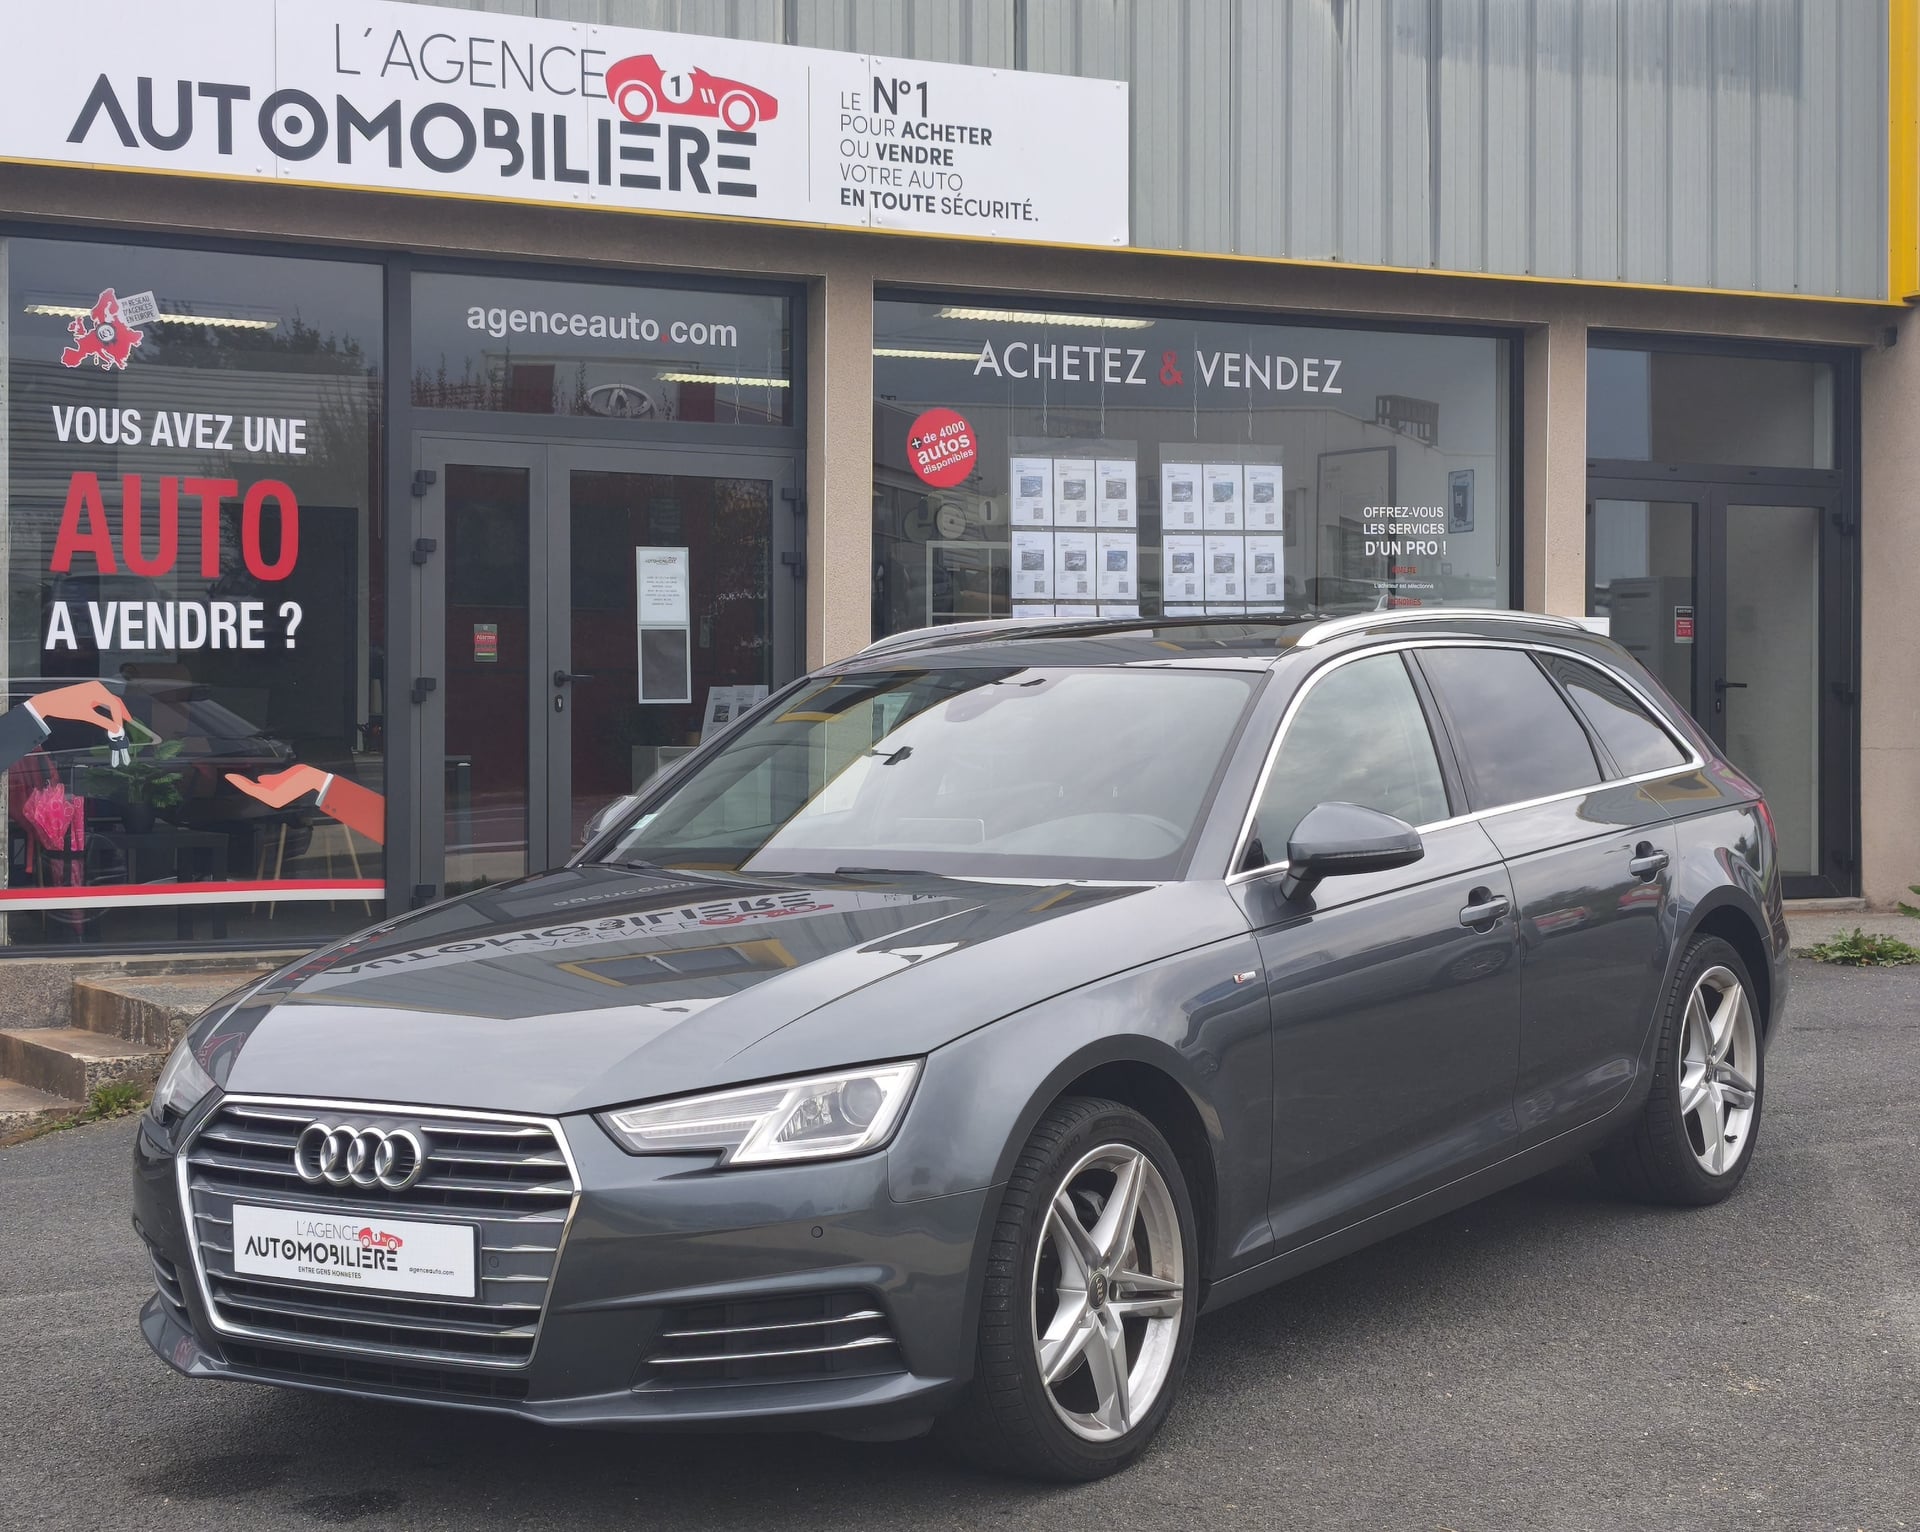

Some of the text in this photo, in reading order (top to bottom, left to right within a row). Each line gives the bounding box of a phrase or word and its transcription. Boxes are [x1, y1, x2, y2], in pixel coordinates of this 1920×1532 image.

[335, 22, 607, 98] L'AGENCE
[670, 75, 681, 97] 1
[841, 91, 861, 111] LE
[66, 73, 757, 198] AUTOMOBILIERE
[840, 114, 992, 146] POUR ACHETER
[840, 138, 954, 167] OU VENDRE
[840, 162, 963, 192] VOTRE AUTO
[840, 187, 1039, 222] EN TOUTE SÉCURITÉ.
[467, 306, 737, 347] agenceauto.com
[973, 339, 1344, 395] ACHETEZ & VENDEZ
[52, 405, 307, 454] VOUS AVEZ UNE
[923, 433, 937, 444] de
[940, 420, 965, 438] 4000
[917, 433, 970, 465] autos
[923, 448, 974, 474] disponibles
[49, 471, 300, 582] AUTO
[1363, 506, 1444, 519] OFFREZ-VOUS
[1363, 523, 1445, 535] LES SERVICES
[1365, 540, 1447, 556] D'UN PRO !
[44, 600, 303, 651] A VENDRE ?
[296, 1220, 360, 1242] L'AGENCE
[245, 1236, 398, 1271] AUTOMOBILIERE
[316, 1267, 331, 1277] GENS
